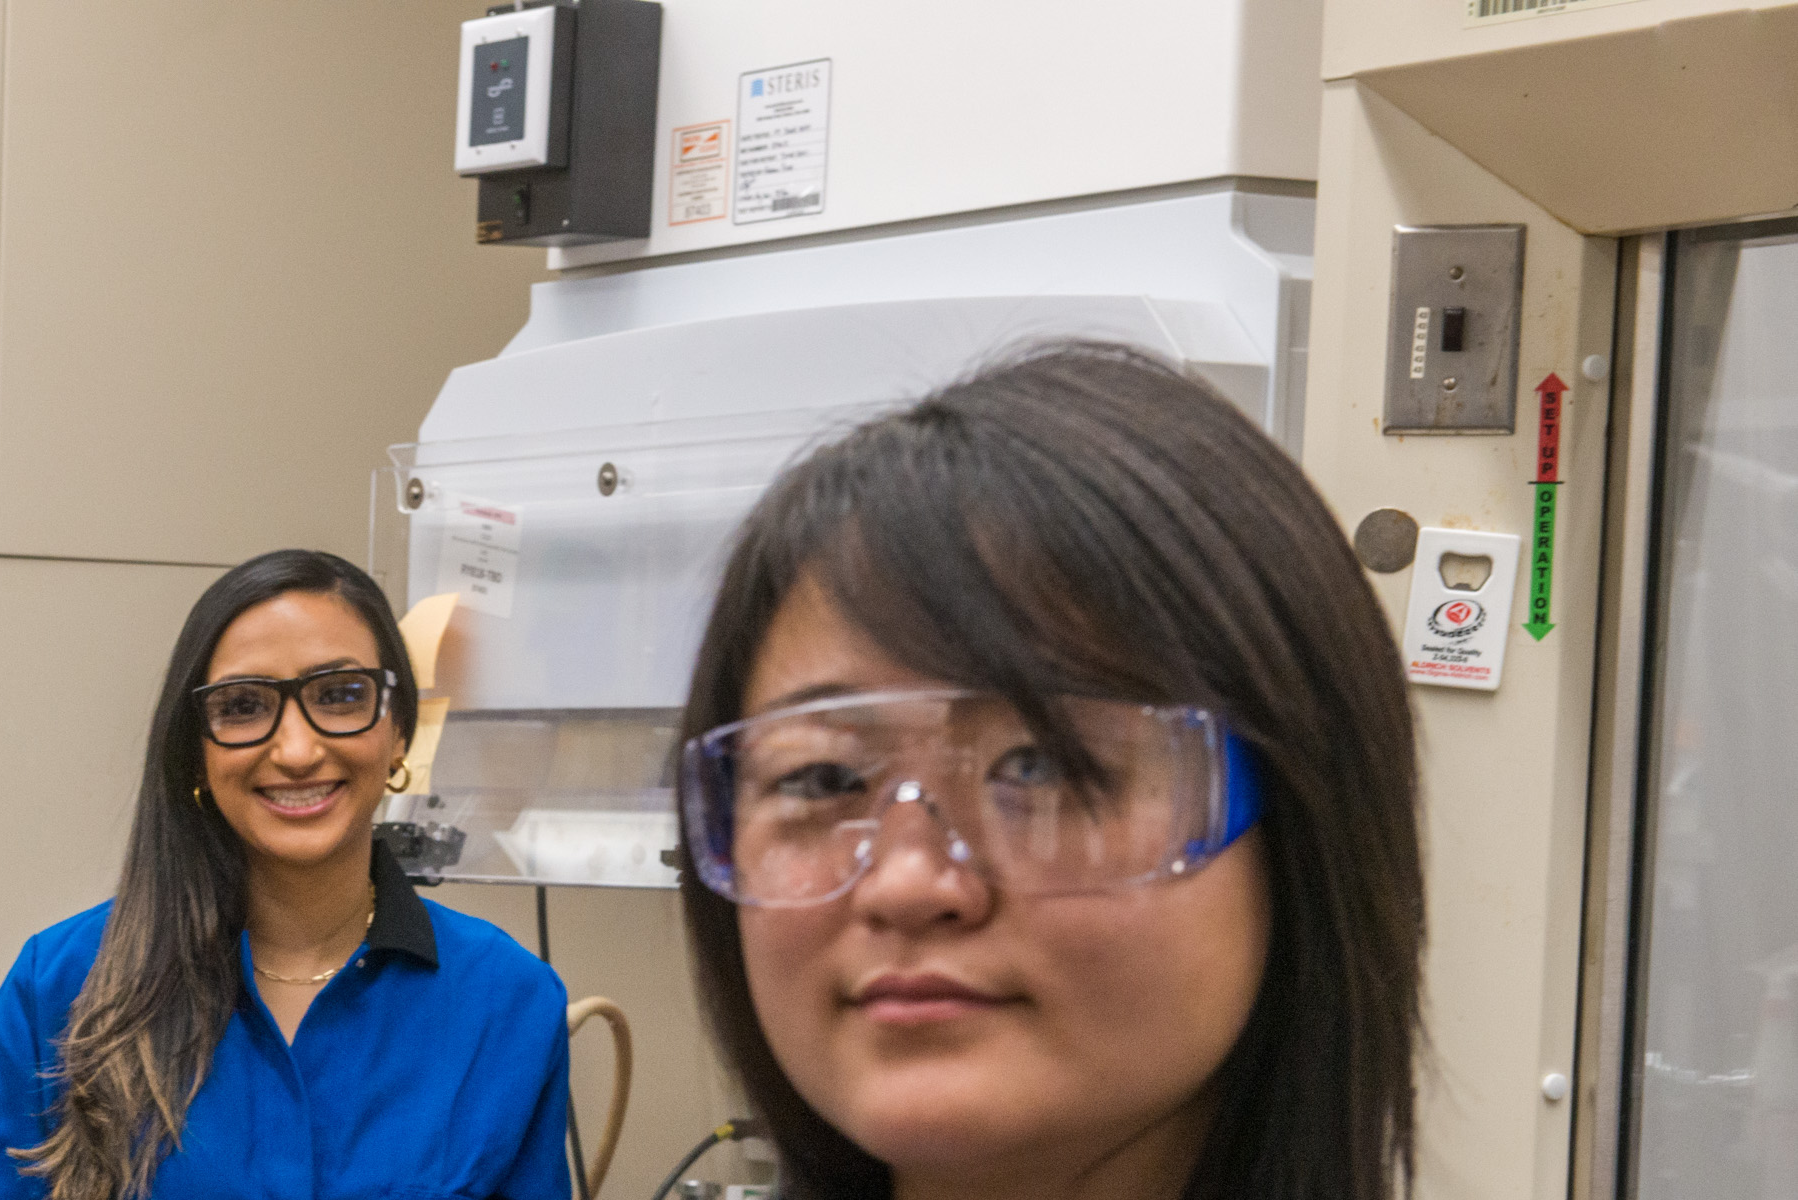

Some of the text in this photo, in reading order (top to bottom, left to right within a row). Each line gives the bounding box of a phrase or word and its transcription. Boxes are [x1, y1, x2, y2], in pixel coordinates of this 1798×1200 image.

[767, 68, 820, 95] STERIS
[1541, 392, 1557, 475] SET UP
[1533, 490, 1553, 625] OPERATION
